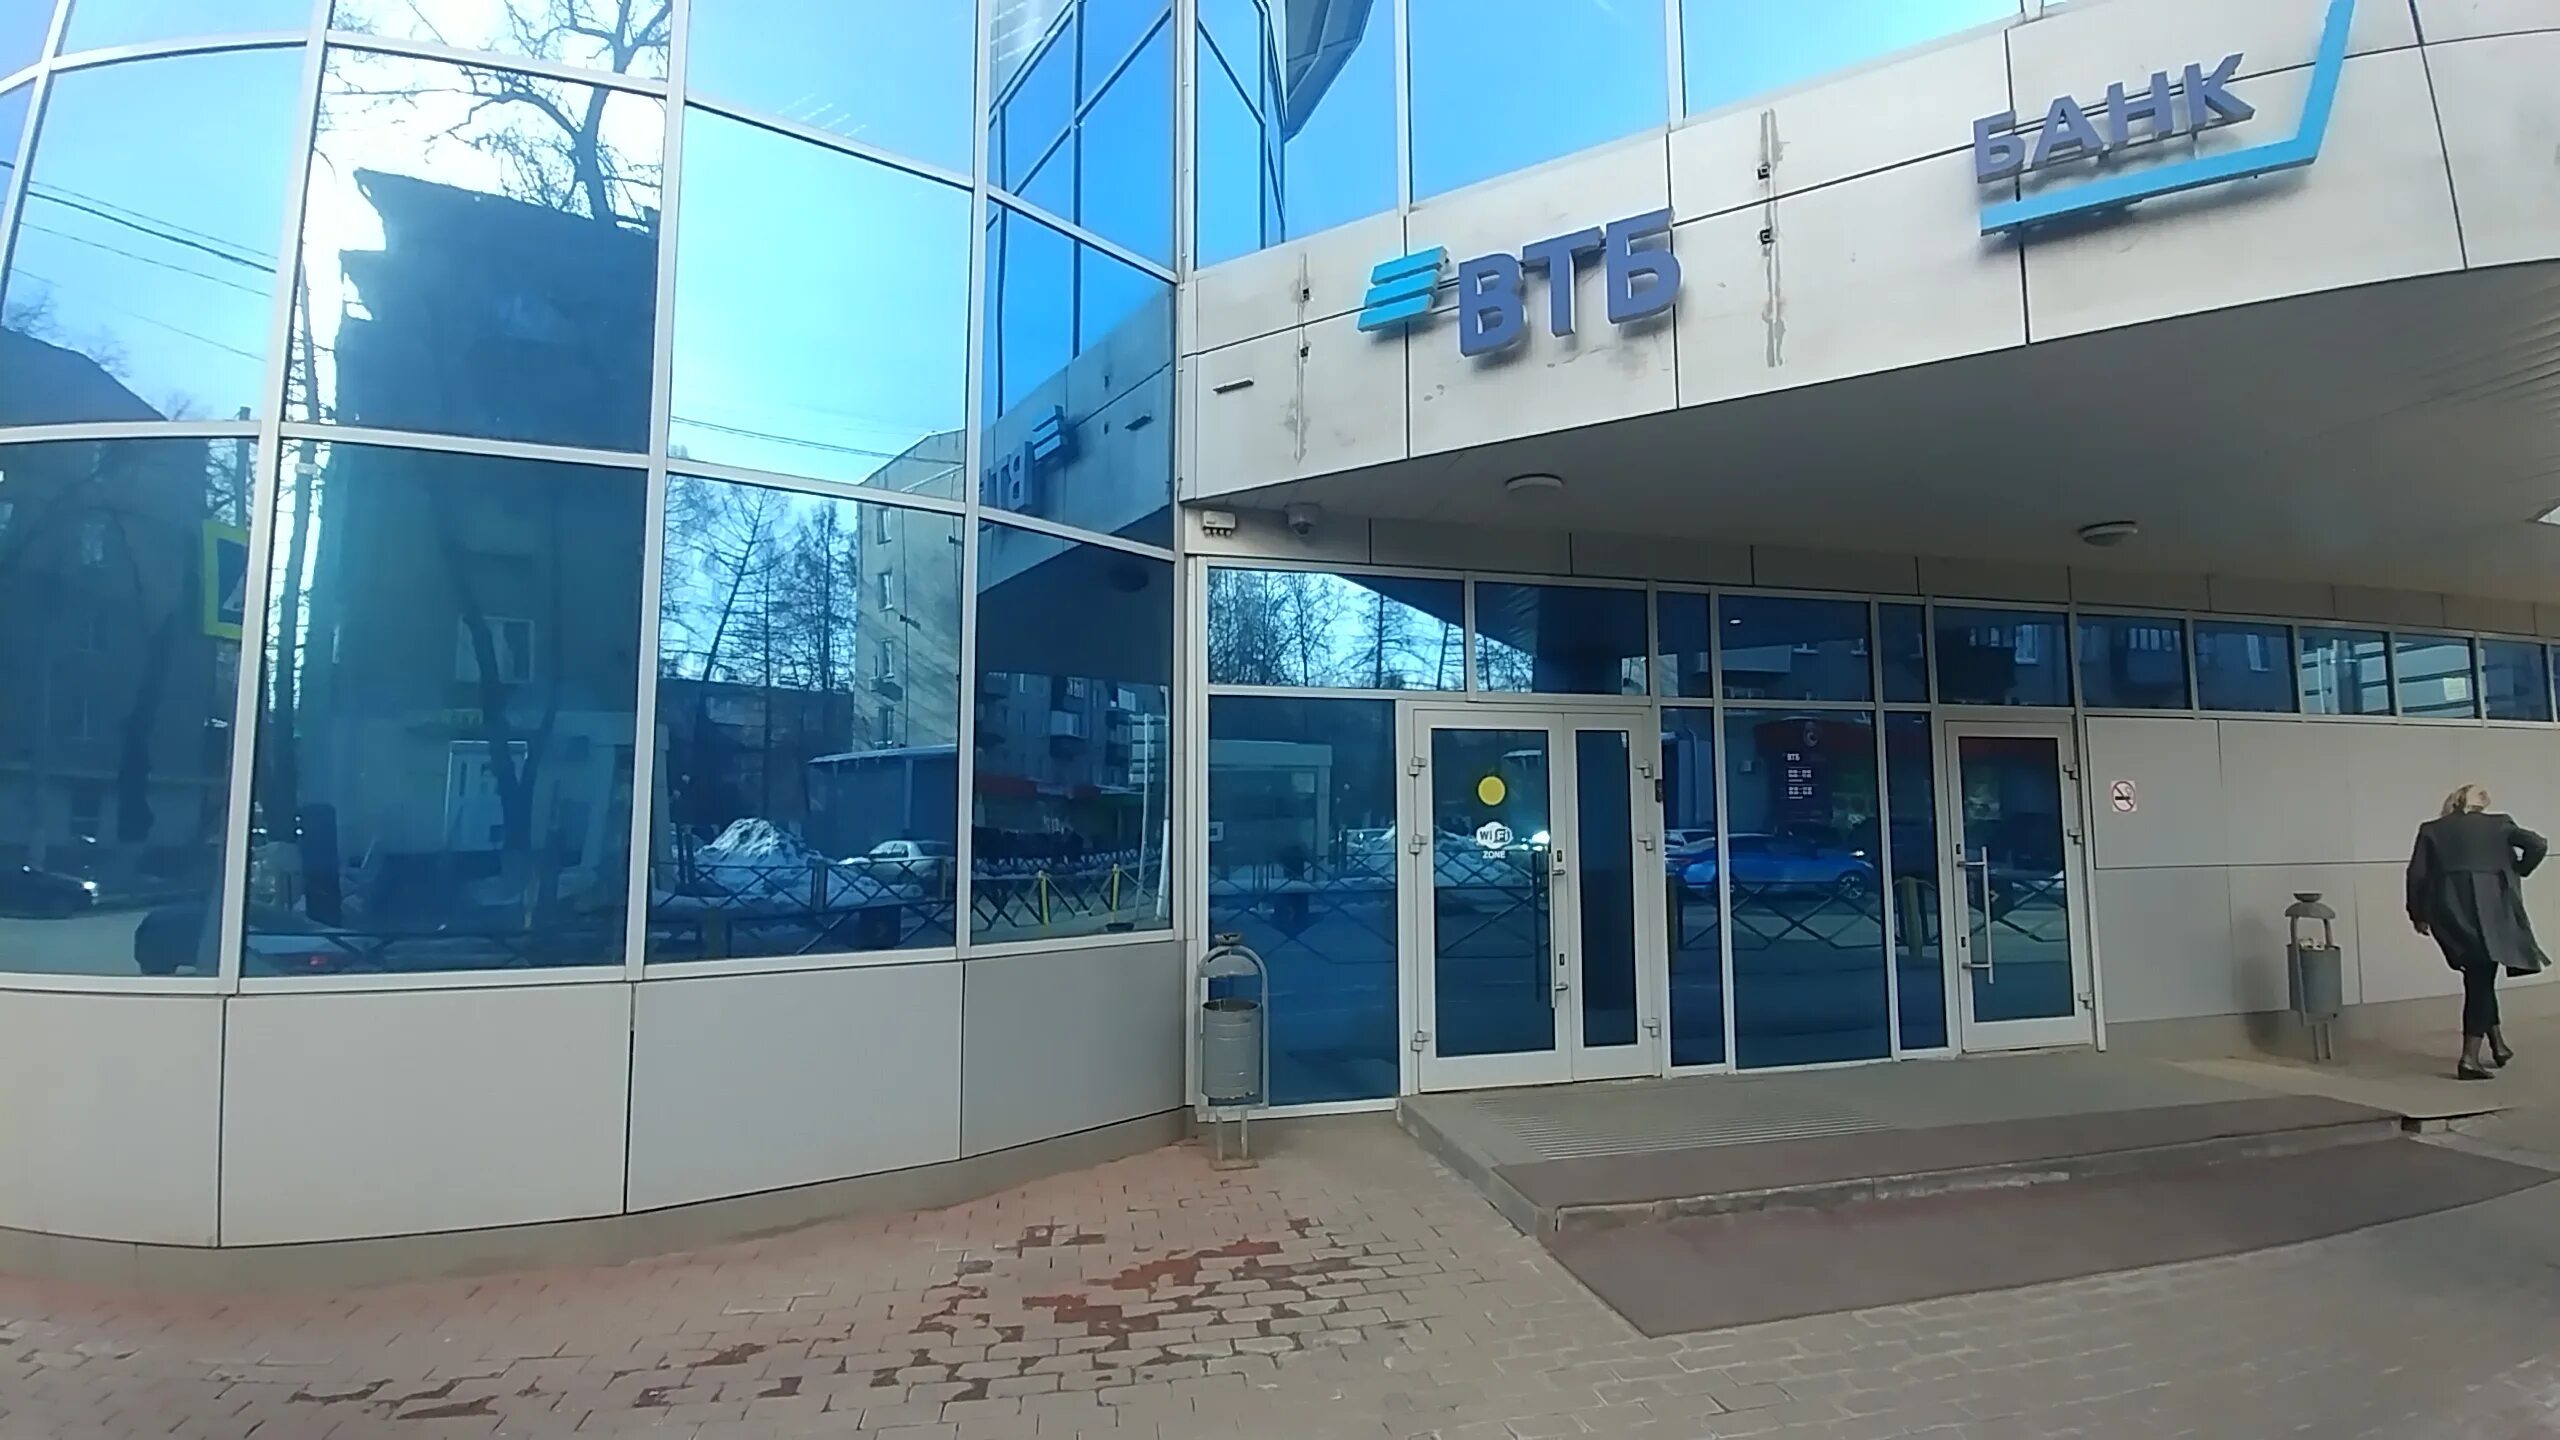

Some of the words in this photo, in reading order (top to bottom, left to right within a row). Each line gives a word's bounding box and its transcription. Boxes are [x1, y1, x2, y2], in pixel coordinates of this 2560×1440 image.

[1973, 52, 2255, 183] БАНК
[1459, 207, 1682, 357] ВТБ
[1482, 850, 1506, 859] ZONE
